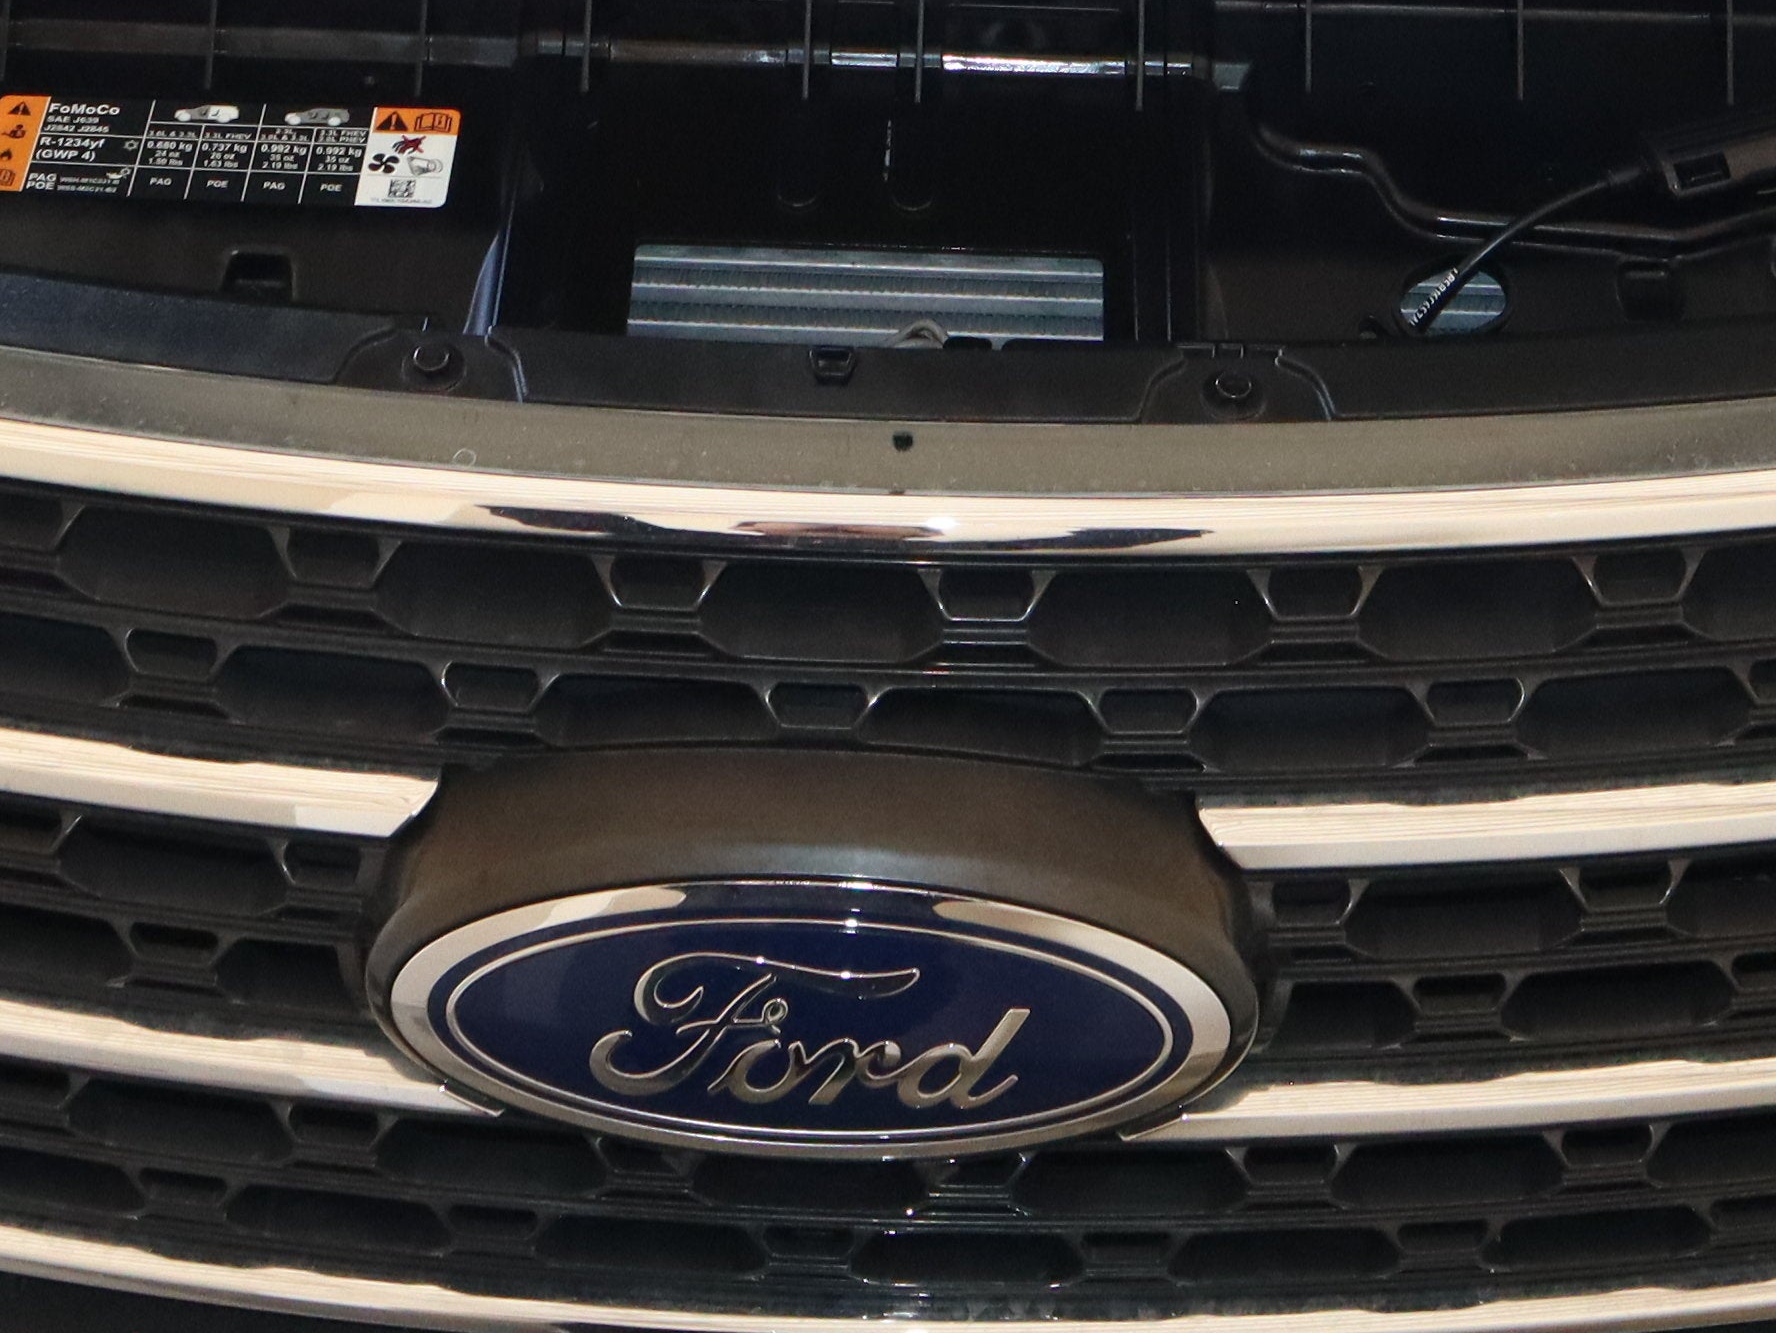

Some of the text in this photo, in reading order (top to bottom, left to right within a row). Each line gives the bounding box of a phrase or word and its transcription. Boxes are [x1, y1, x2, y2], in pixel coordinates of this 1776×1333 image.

[48, 103, 121, 115] FoMoCo
[46, 115, 71, 123] SAE
[39, 137, 105, 149] R-1234yf
[178, 141, 193, 152] kg
[201, 142, 248, 153] 0.737 kg
[35, 149, 96, 162] (GWP 4)
[260, 144, 308, 156] 0.992 kg
[316, 146, 363, 158] 0.992 kg
[28, 173, 57, 182] PAG
[149, 177, 172, 186] PAG
[26, 181, 56, 190] POE
[206, 179, 229, 188] POE
[263, 181, 285, 190] PAG
[320, 184, 342, 192] POE
[588, 951, 1031, 1109] Ford
